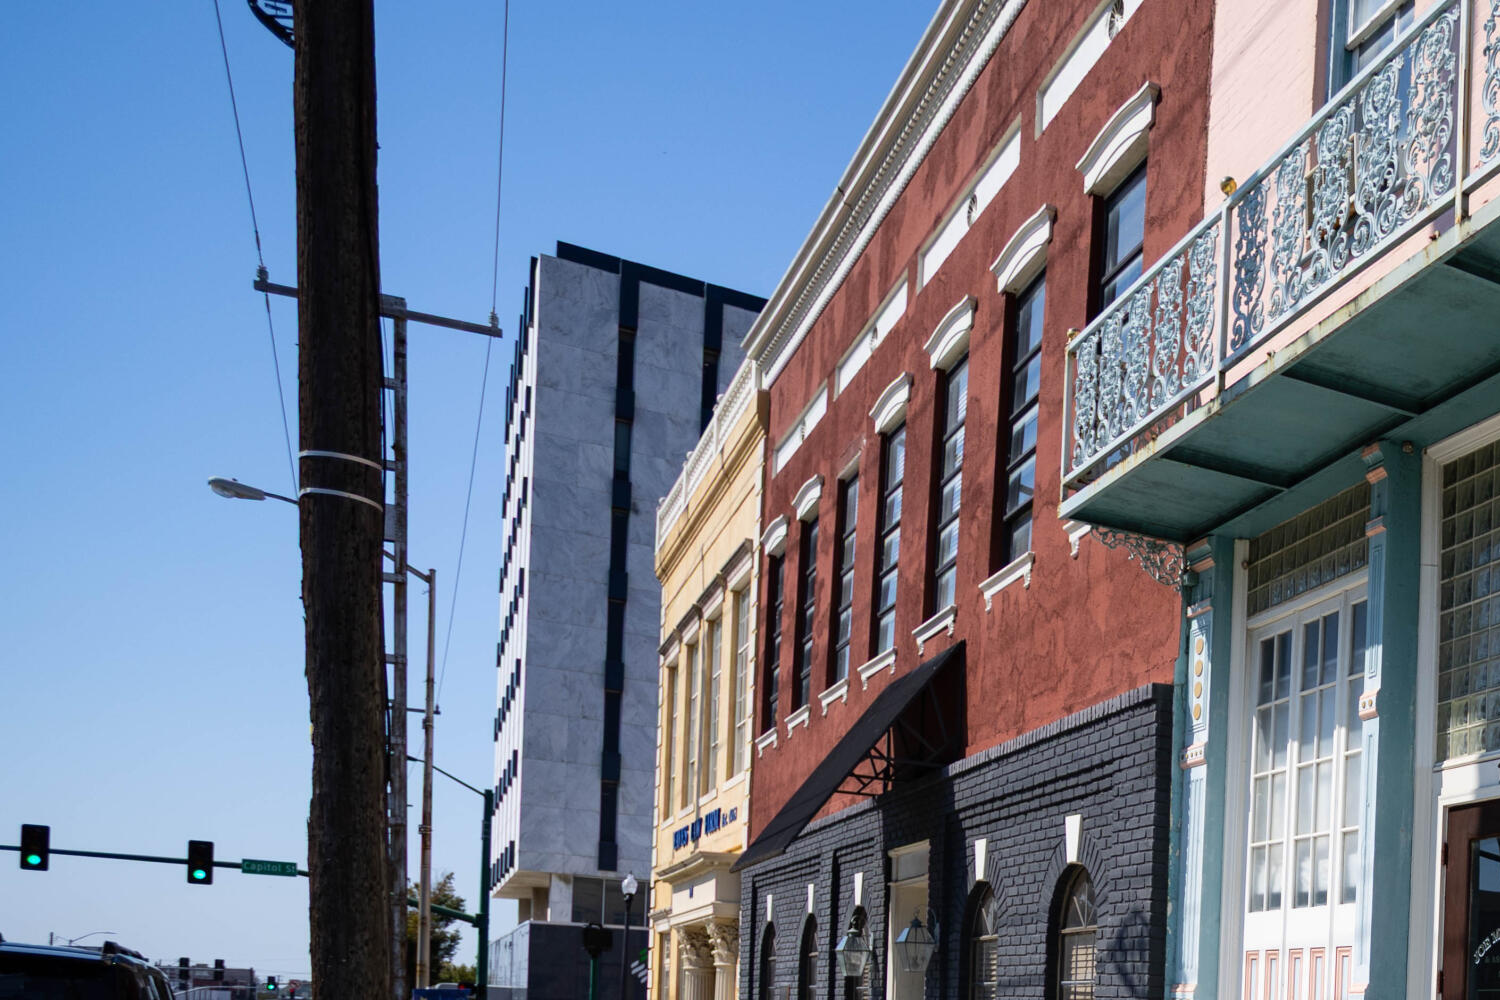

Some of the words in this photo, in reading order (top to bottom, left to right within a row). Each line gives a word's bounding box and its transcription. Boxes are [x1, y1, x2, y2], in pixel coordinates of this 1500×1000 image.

[243, 861, 283, 873] Capitol
[286, 864, 296, 873] St
[1473, 937, 1492, 965] JOE
